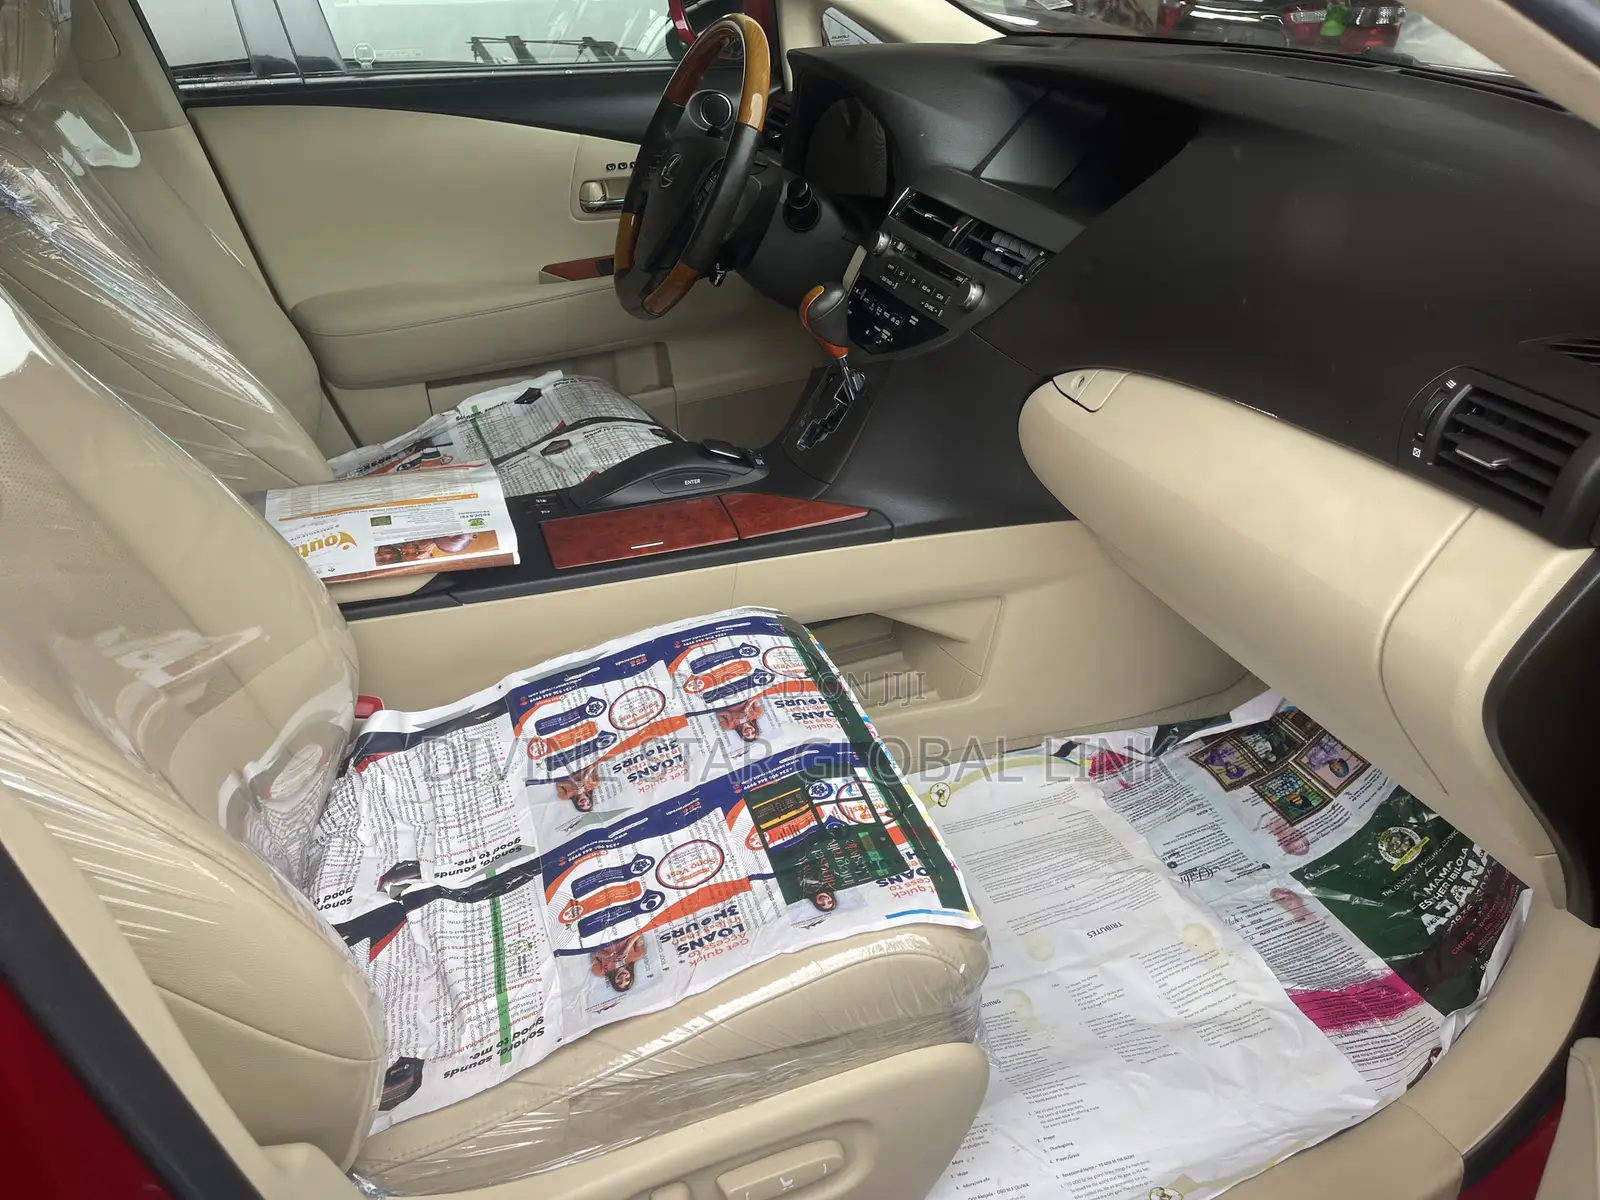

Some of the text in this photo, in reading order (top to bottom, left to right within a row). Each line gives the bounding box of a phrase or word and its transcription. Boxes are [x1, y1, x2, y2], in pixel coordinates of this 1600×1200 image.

[684, 478, 701, 486] ENTER
[790, 709, 834, 721] OANS
[804, 722, 832, 731] quick
[611, 738, 678, 773] 3HOURS
[626, 753, 682, 782] LOANS
[637, 768, 687, 793] Get quick
[433, 844, 522, 879] Sonora, sounds
[454, 836, 521, 868] good to me.
[690, 857, 715, 870] Sono
[891, 884, 926, 898] quick
[904, 877, 930, 888] cess
[1418, 847, 1469, 910] ESTHER IBILOLA
[1422, 859, 1454, 895] MAMA
[658, 903, 739, 944] 3HOURS
[1086, 920, 1123, 938] TRIBUTES
[670, 931, 700, 946] than
[675, 923, 744, 955] LOANS
[687, 931, 747, 958] Access to
[687, 937, 749, 967] Get quick
[1450, 931, 1477, 955] CHRIST
[442, 1025, 547, 1080] Sonora, sounds
[468, 1015, 544, 1062] good to me.
